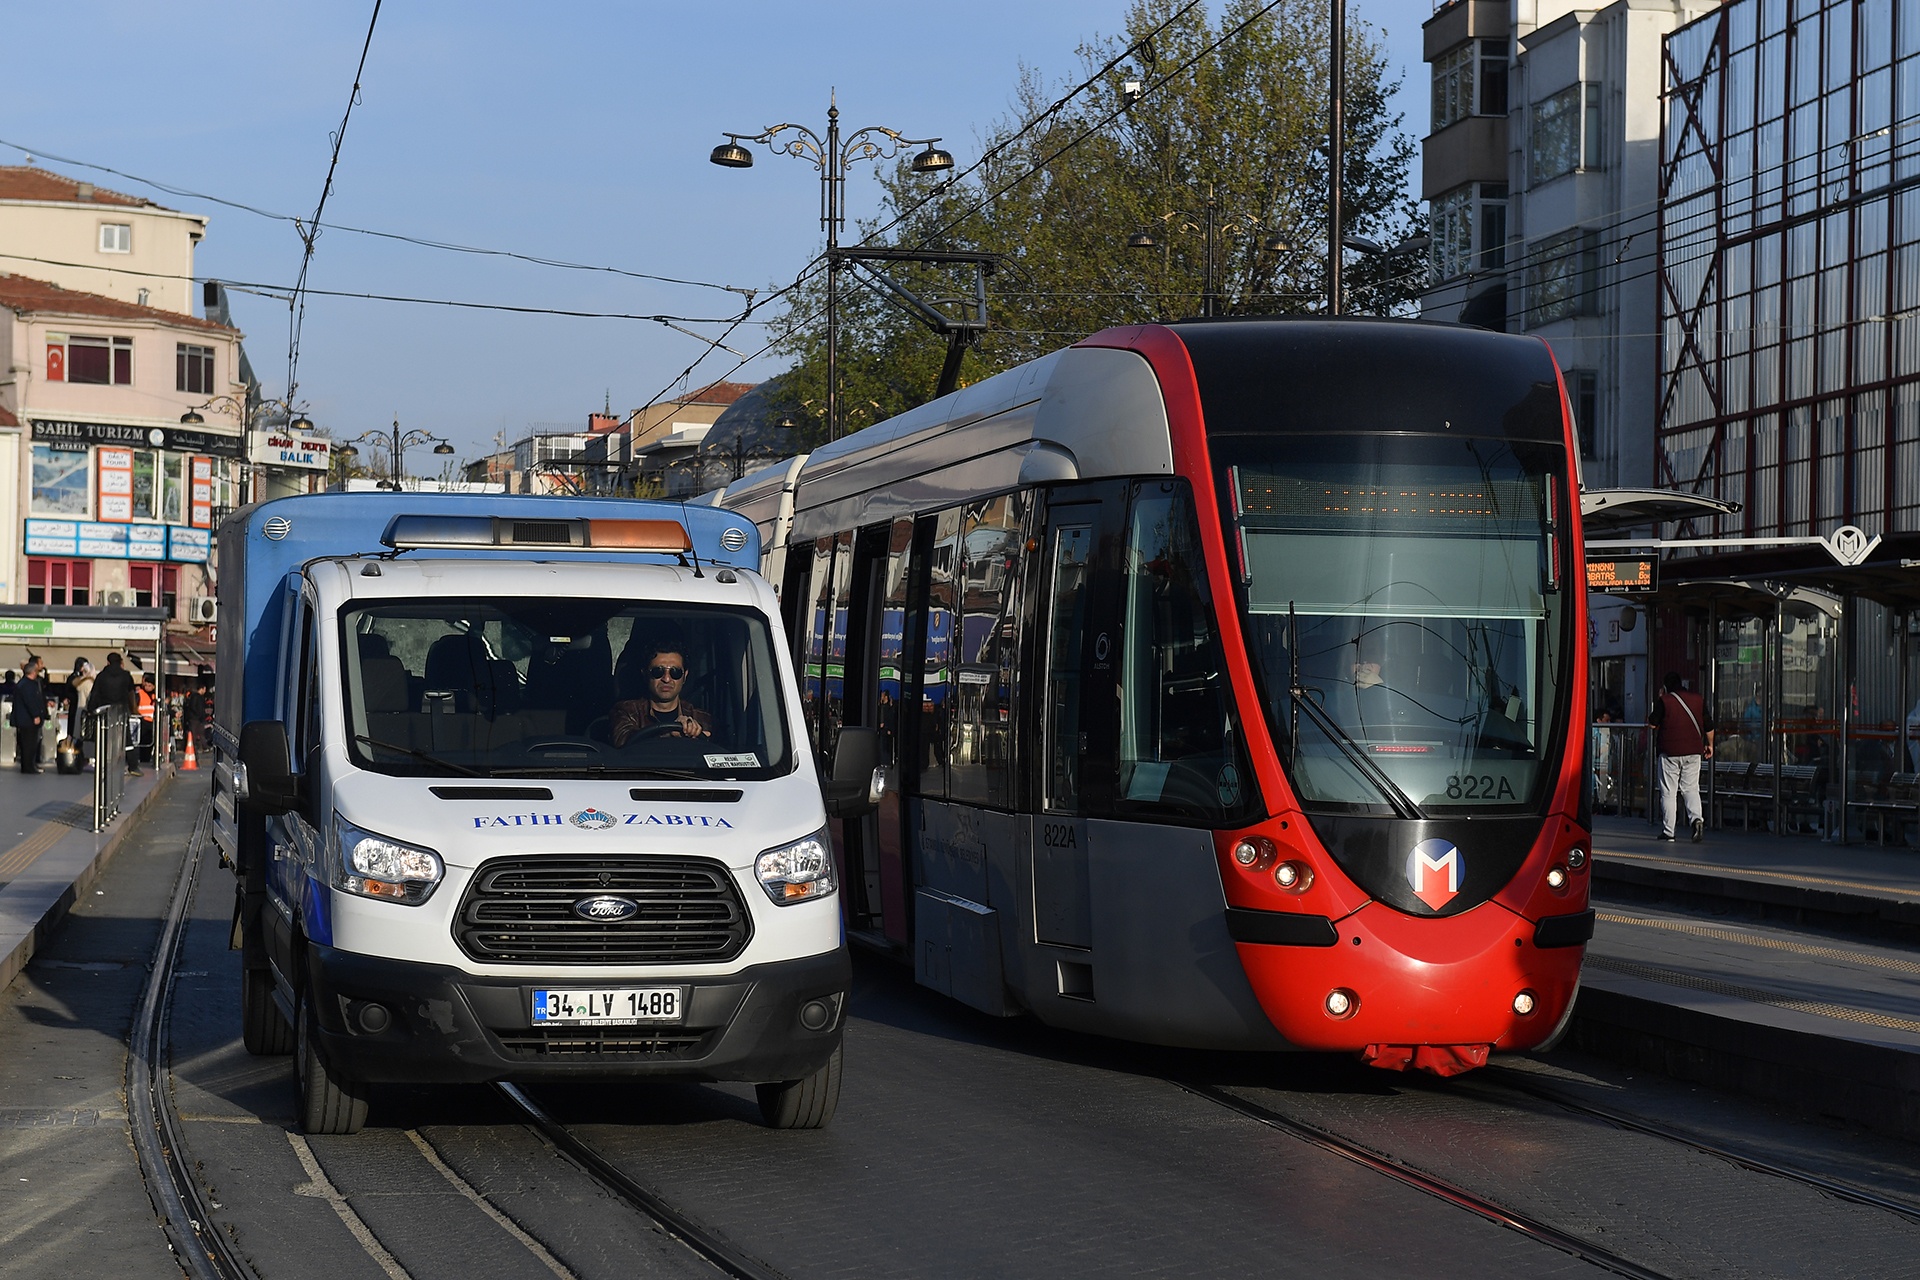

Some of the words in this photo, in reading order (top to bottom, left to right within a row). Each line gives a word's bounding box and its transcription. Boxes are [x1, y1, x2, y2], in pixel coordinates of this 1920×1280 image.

[36, 422, 82, 437] SAHİL
[87, 426, 144, 440] TURİZM
[280, 451, 313, 464] BALIK
[1446, 775, 1515, 800] 822A
[473, 812, 563, 828] FATİH
[622, 813, 734, 828] ZABITA
[1044, 823, 1077, 849] 822A
[589, 900, 624, 917] Ford
[537, 1007, 546, 1015] TR
[548, 994, 573, 1017] 34
[589, 994, 614, 1016] LV
[628, 992, 675, 1016] 1488
